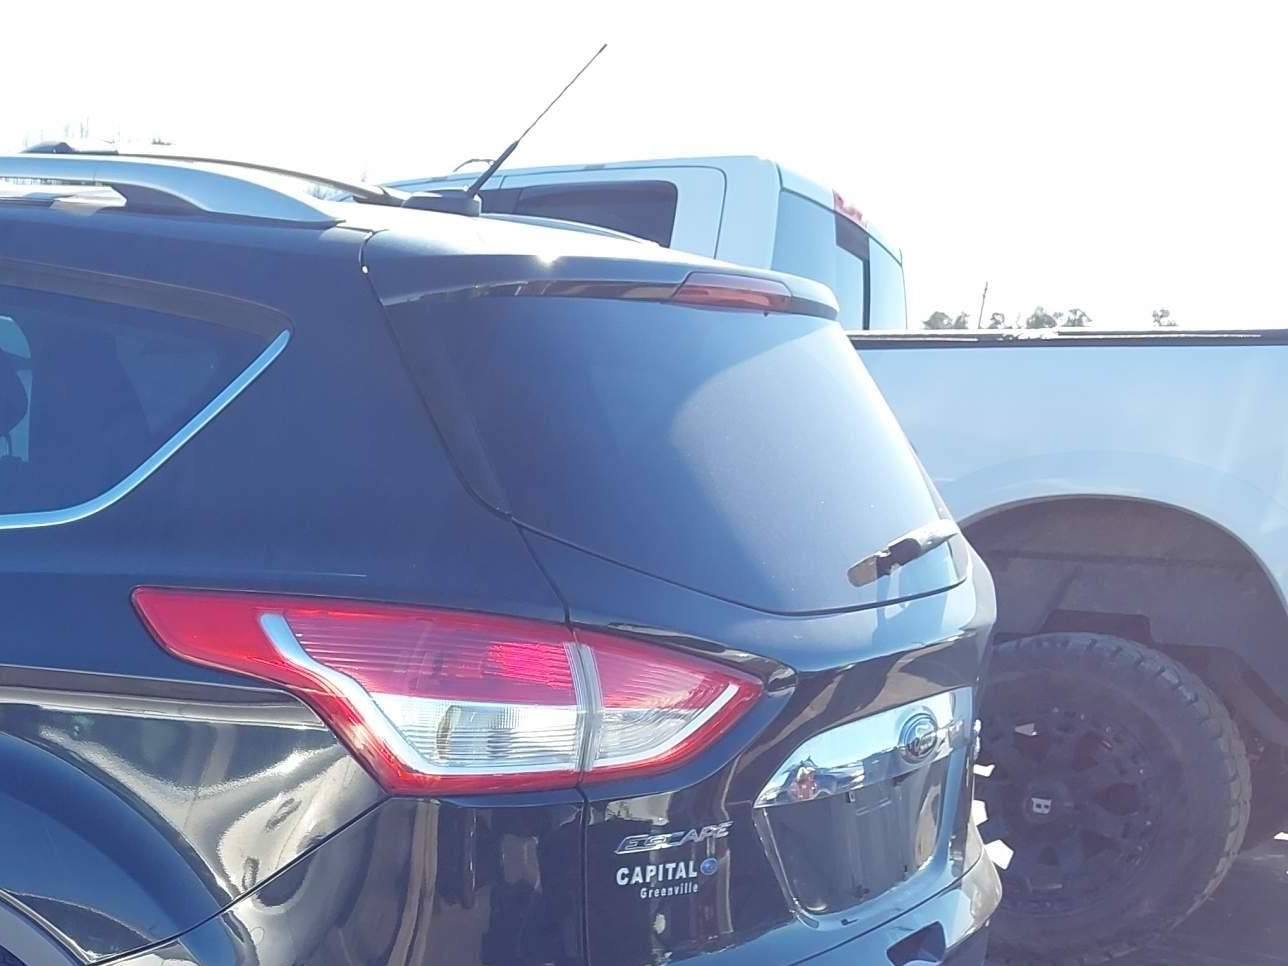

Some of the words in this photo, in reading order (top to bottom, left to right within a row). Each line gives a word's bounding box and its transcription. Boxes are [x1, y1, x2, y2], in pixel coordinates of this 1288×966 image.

[614, 821, 733, 855] ESCAPE
[616, 861, 698, 886] CAPITAL
[640, 882, 699, 899] Greenville
